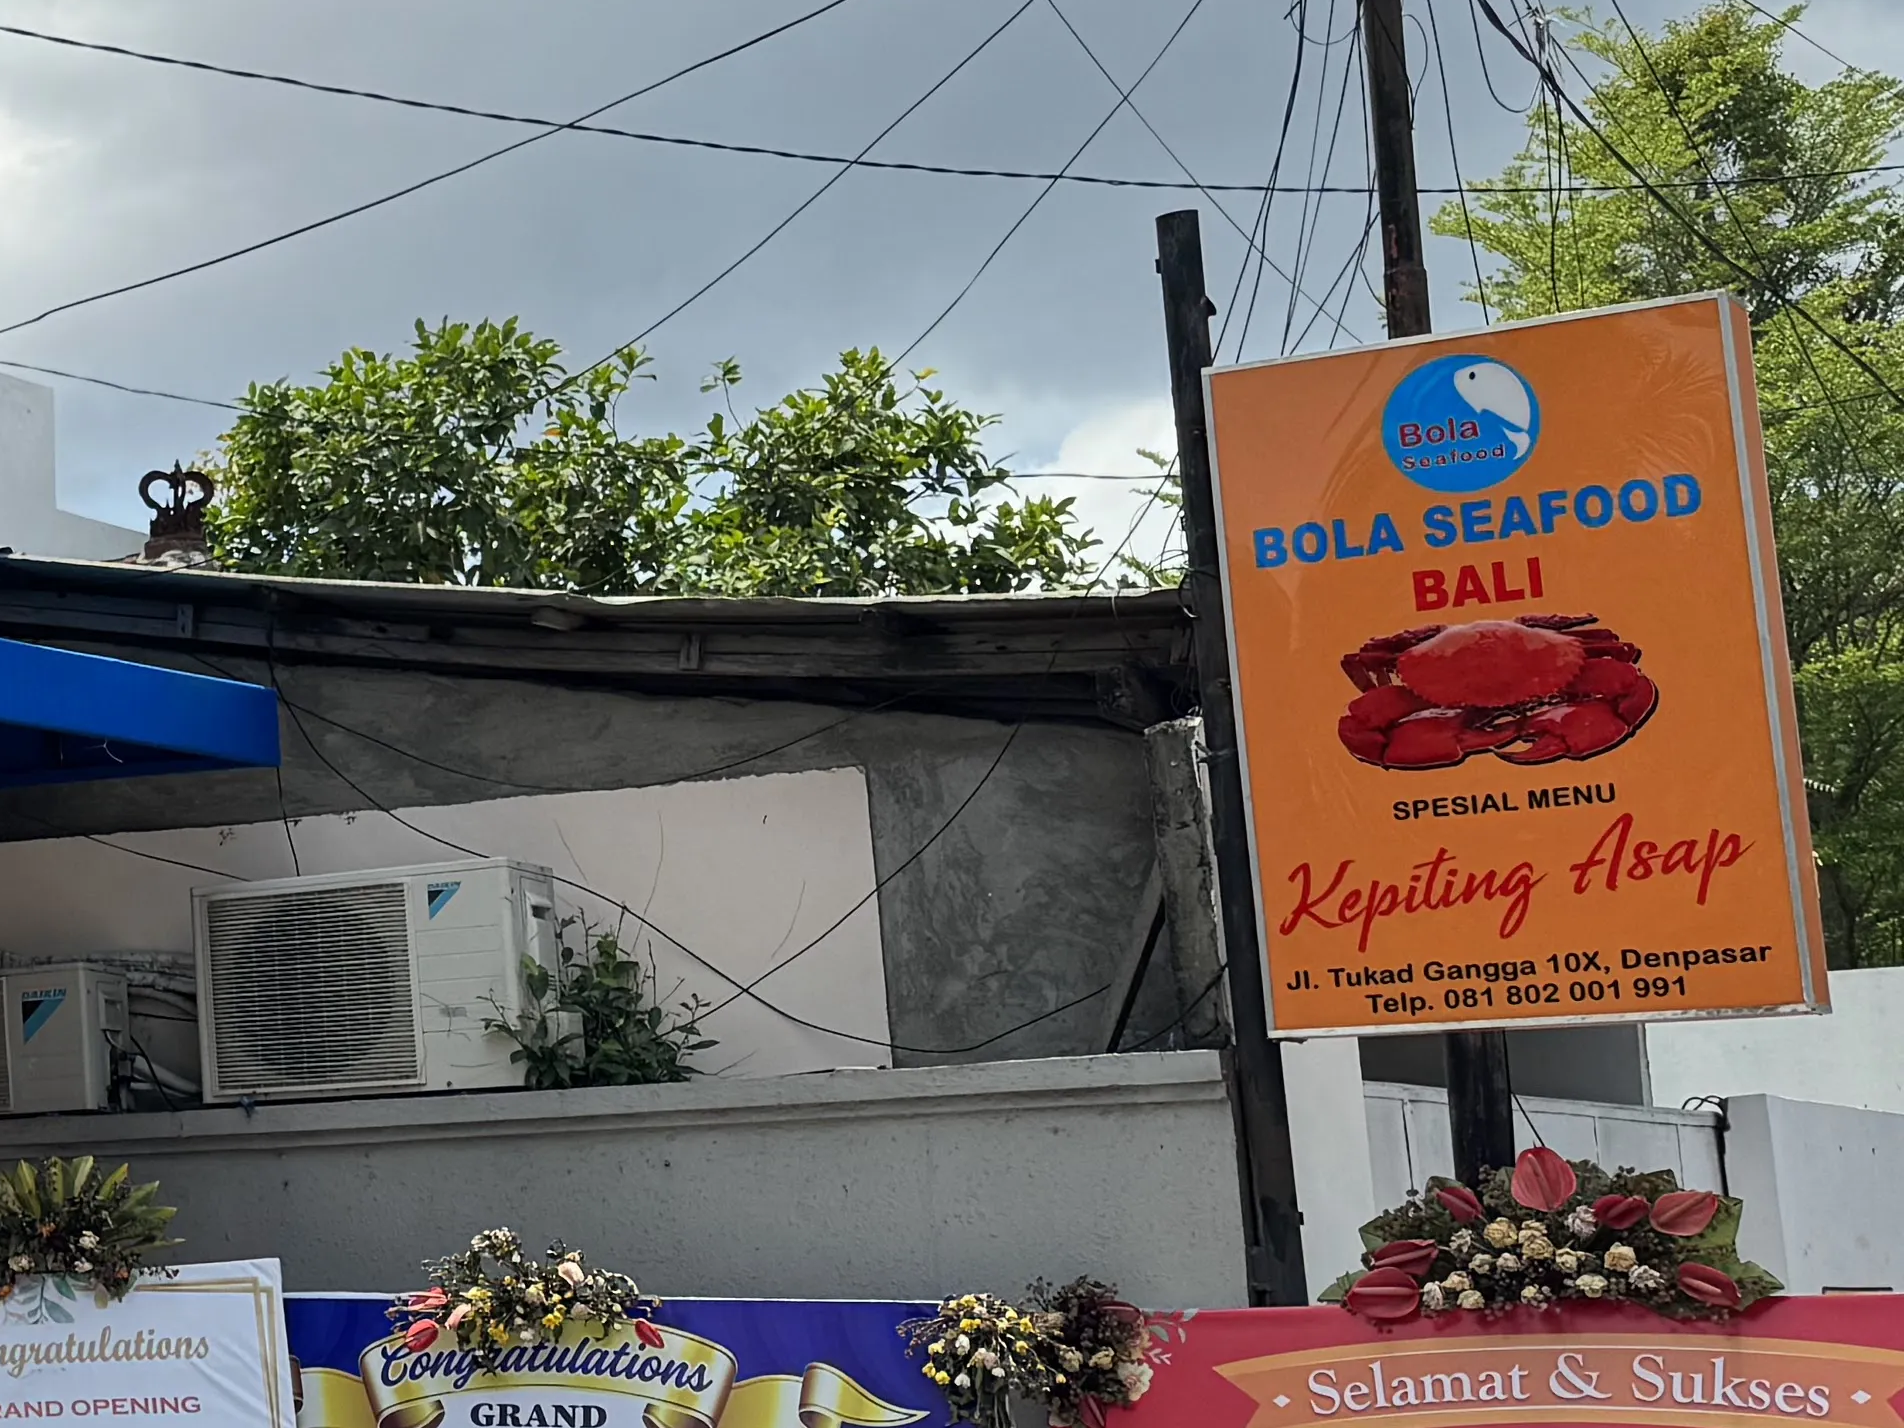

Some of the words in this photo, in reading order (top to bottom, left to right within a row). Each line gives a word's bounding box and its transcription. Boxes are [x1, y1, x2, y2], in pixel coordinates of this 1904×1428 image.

[1399, 417, 1480, 449] Bola
[1402, 443, 1506, 471] Seafood
[1253, 514, 1404, 568] BOLA
[1422, 473, 1702, 549] SEAFOOD
[1412, 557, 1544, 612] BALI
[1392, 792, 1519, 822] SPESIAL
[1527, 782, 1617, 811] MENU
[1279, 846, 1548, 954] Kepiting
[1569, 812, 1756, 907] Asap
[1326, 963, 1414, 989] Tukad
[1423, 956, 1537, 988] Gangga
[1545, 950, 1612, 976] 10X,
[1620, 944, 1773, 974] Denpasar
[1365, 992, 1434, 1017] Telp.
[1443, 986, 1494, 1011] 081
[1505, 982, 1561, 1007] 802
[1569, 978, 1622, 1004] 001
[1633, 974, 1687, 1000] 991
[71, 1395, 202, 1417] OPENING
[1307, 1358, 1531, 1417] Selamat
[1547, 1352, 1613, 1401] &
[1631, 1352, 1831, 1418] Sukses
[469, 1402, 608, 1428] GRAND
